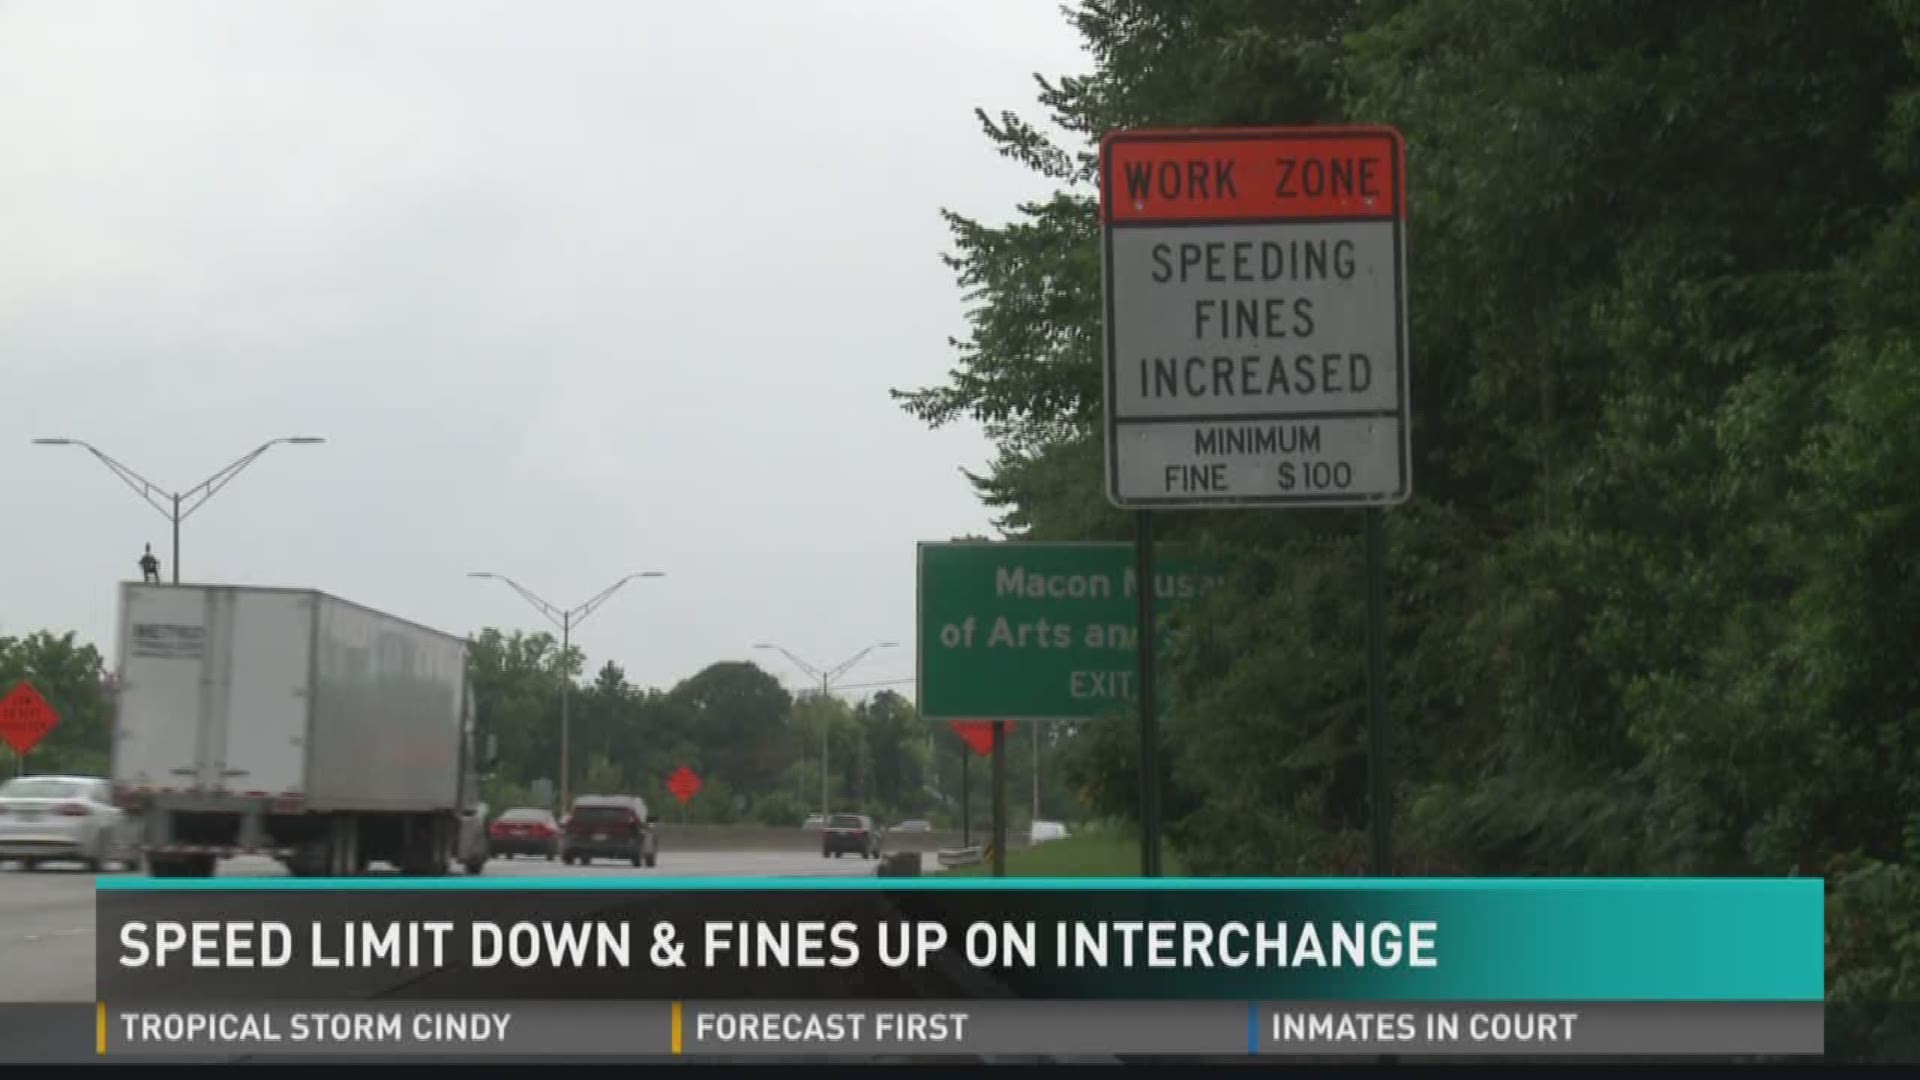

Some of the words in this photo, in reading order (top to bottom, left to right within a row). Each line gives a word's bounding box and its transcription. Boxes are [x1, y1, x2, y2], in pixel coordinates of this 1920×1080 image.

[1124, 160, 1238, 199] WORK
[1276, 157, 1380, 197] ZONE
[1151, 239, 1356, 283] SPEEDING
[1195, 298, 1316, 339] FINES
[1141, 353, 1372, 397] INCREASED
[1195, 425, 1321, 455] MINIMUM
[1165, 464, 1229, 492] FINE
[995, 566, 1110, 598] Macon
[940, 616, 977, 648] of
[987, 616, 1072, 649] Arts
[1084, 621, 1138, 649] an
[1069, 671, 1135, 698] EXIT
